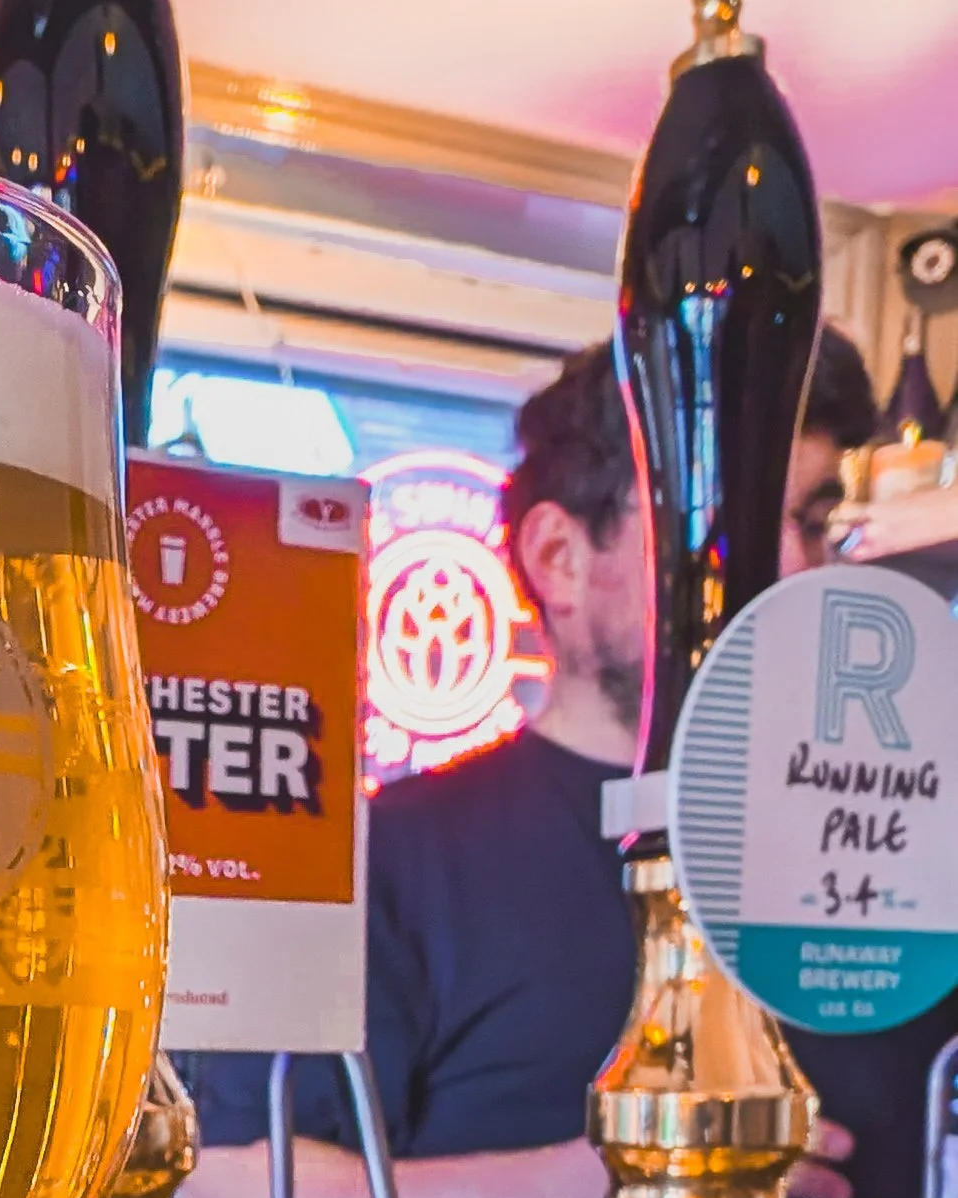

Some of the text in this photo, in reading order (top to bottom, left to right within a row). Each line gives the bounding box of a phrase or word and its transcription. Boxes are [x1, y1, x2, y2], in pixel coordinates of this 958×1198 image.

[815, 588, 915, 750] R
[145, 675, 310, 722] HESTER
[786, 741, 939, 800] RUNNING
[820, 806, 906, 853] PALE
[801, 942, 902, 964] RUNAWAY
[800, 968, 899, 990] BREWERY
